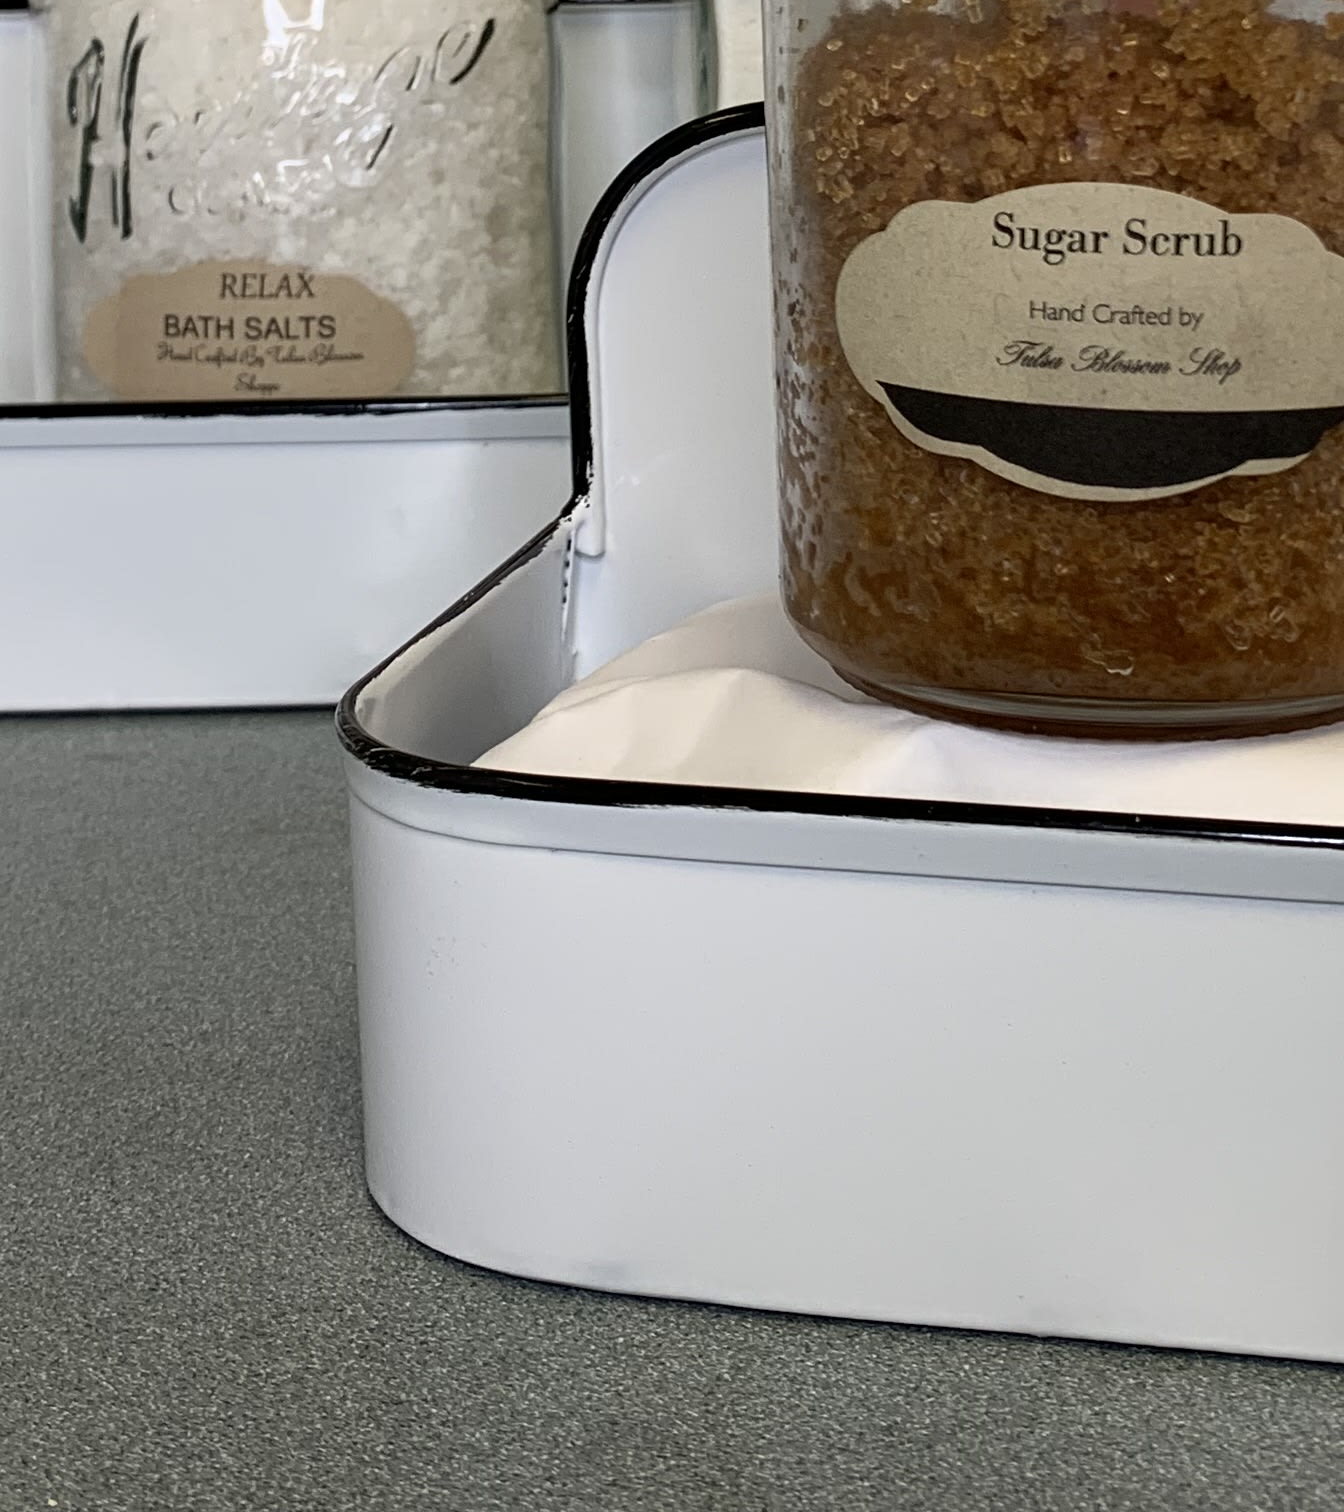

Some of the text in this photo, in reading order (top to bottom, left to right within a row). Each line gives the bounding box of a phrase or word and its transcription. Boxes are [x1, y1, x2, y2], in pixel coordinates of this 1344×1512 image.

[991, 211, 1244, 266] Sugar Scrub
[219, 272, 316, 300] RELAX
[164, 313, 337, 340] BATH SALTS
[1028, 299, 1204, 331] Hand Crafted by
[994, 339, 1243, 386] Tulsa Blossom Shop
